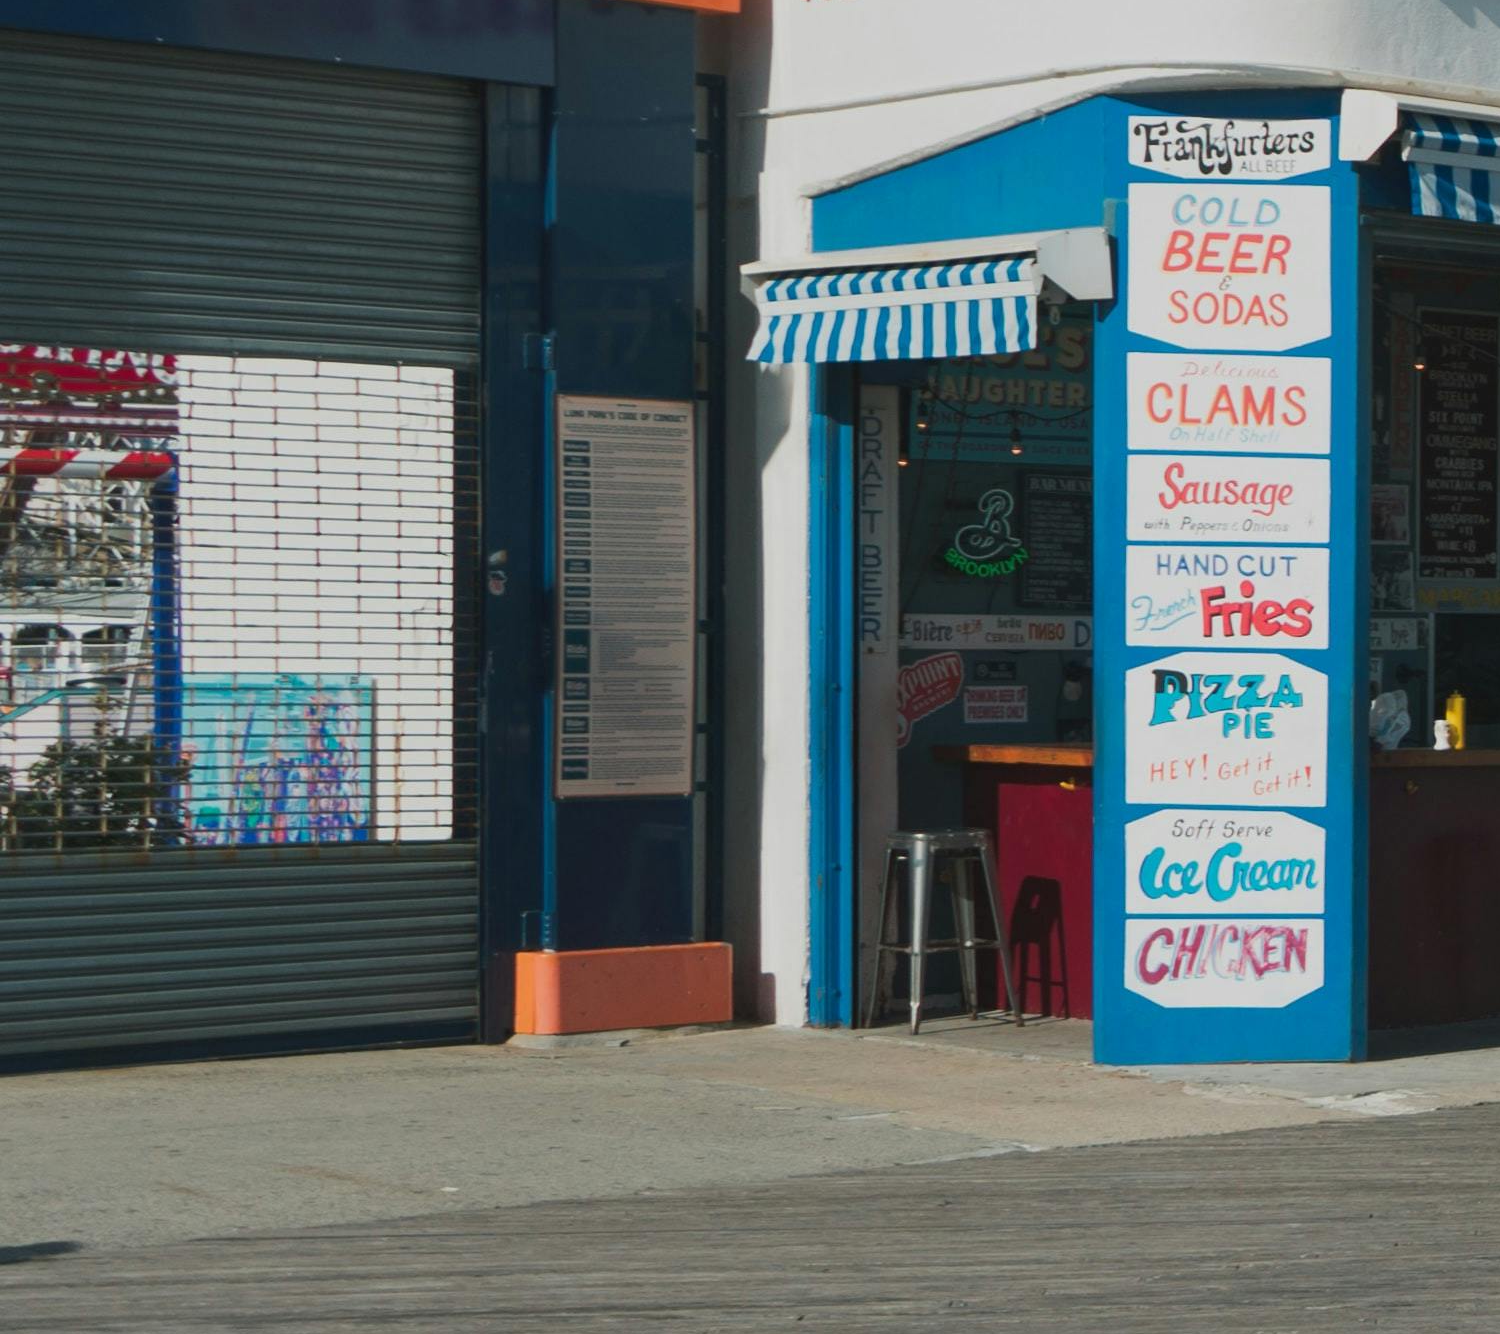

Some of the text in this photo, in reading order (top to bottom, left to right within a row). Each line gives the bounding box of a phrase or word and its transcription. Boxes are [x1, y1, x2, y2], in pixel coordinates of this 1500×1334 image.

[1134, 120, 1315, 175] Frankfurters
[1240, 160, 1297, 173] ALL BEEF
[1172, 194, 1281, 227] COLD
[1161, 230, 1292, 275] BEER
[1218, 275, 1232, 291] &
[1168, 290, 1289, 327] SODAS
[1180, 361, 1280, 380] Delicious
[1146, 382, 1308, 427] CLAMS
[1169, 427, 1280, 443] On Half Shell
[1158, 462, 1293, 516] Sausage
[861, 417, 883, 642] DRAFT BEER
[1144, 518, 1170, 531] with
[1242, 518, 1289, 533] Onions
[944, 548, 1029, 578] BROOKLYN
[1157, 554, 1298, 577] HAND CUT
[1132, 588, 1197, 631] French
[1200, 580, 1314, 637] Fries
[1148, 668, 1304, 727] PIZZA
[1151, 752, 1274, 782] HEY! Get it
[1253, 766, 1313, 796] Get it!
[1171, 818, 1273, 839] Soft Serve
[1139, 842, 1318, 902] Ice Cream
[1136, 923, 1309, 985] CHICKEN
